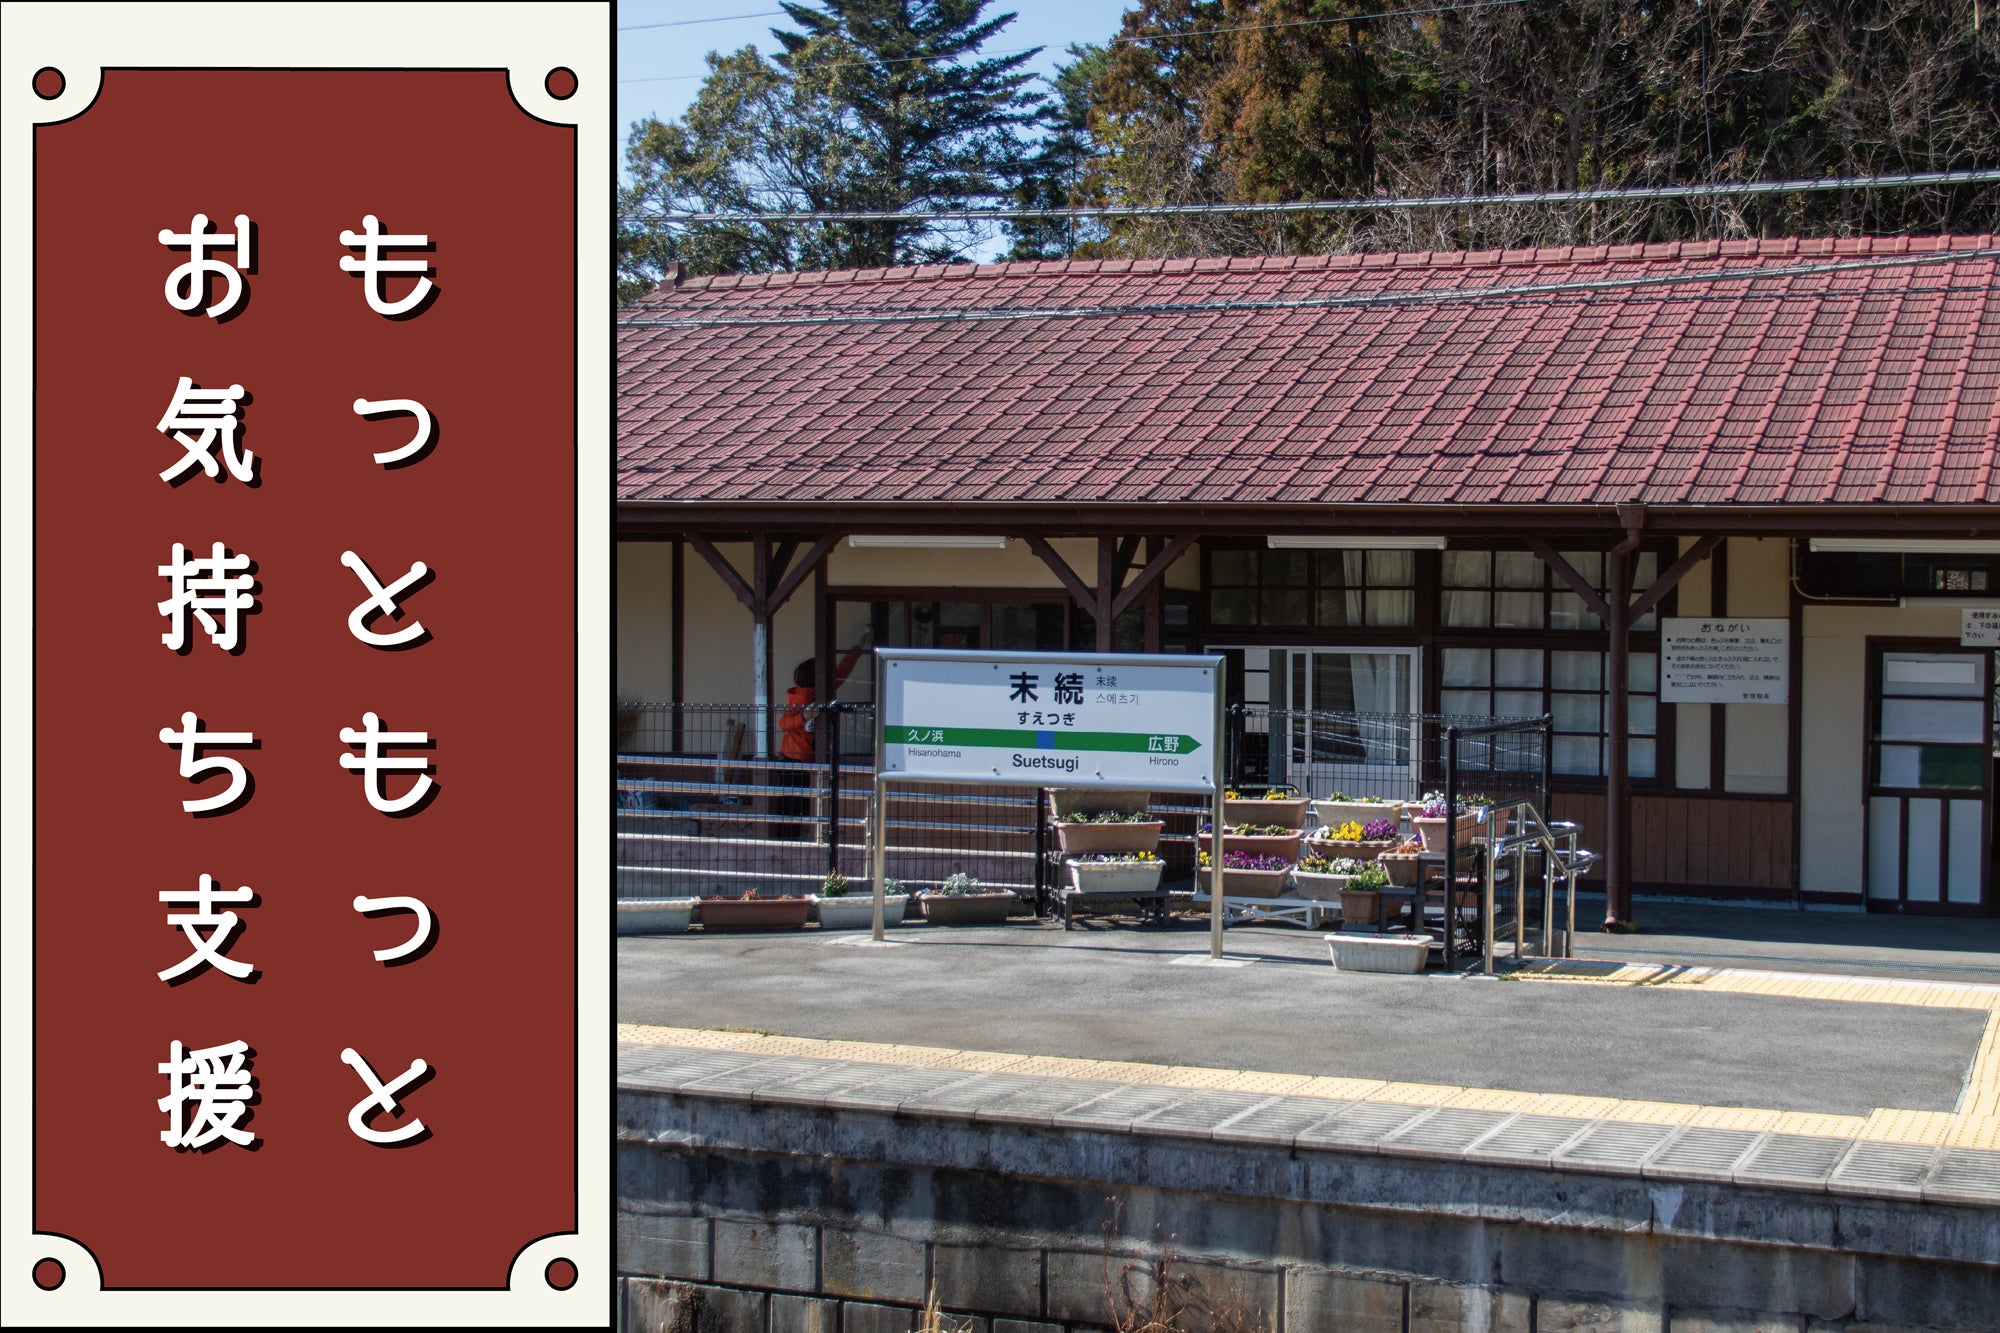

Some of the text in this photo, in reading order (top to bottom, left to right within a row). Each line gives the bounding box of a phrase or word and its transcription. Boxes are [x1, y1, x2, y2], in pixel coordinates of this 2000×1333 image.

[1700, 623, 1750, 633] おねがい
[1095, 675, 1117, 687] 末续
[1009, 671, 1085, 705] 末続
[1095, 693, 1140, 706] 스에츠기
[1017, 711, 1076, 726] すえつぎ
[907, 729, 944, 743] 久ノ浜
[1147, 735, 1179, 752] 広野
[908, 747, 962, 759] Hisanohama
[1012, 753, 1080, 773] Suetsugi
[1149, 755, 1180, 767] Hirono
